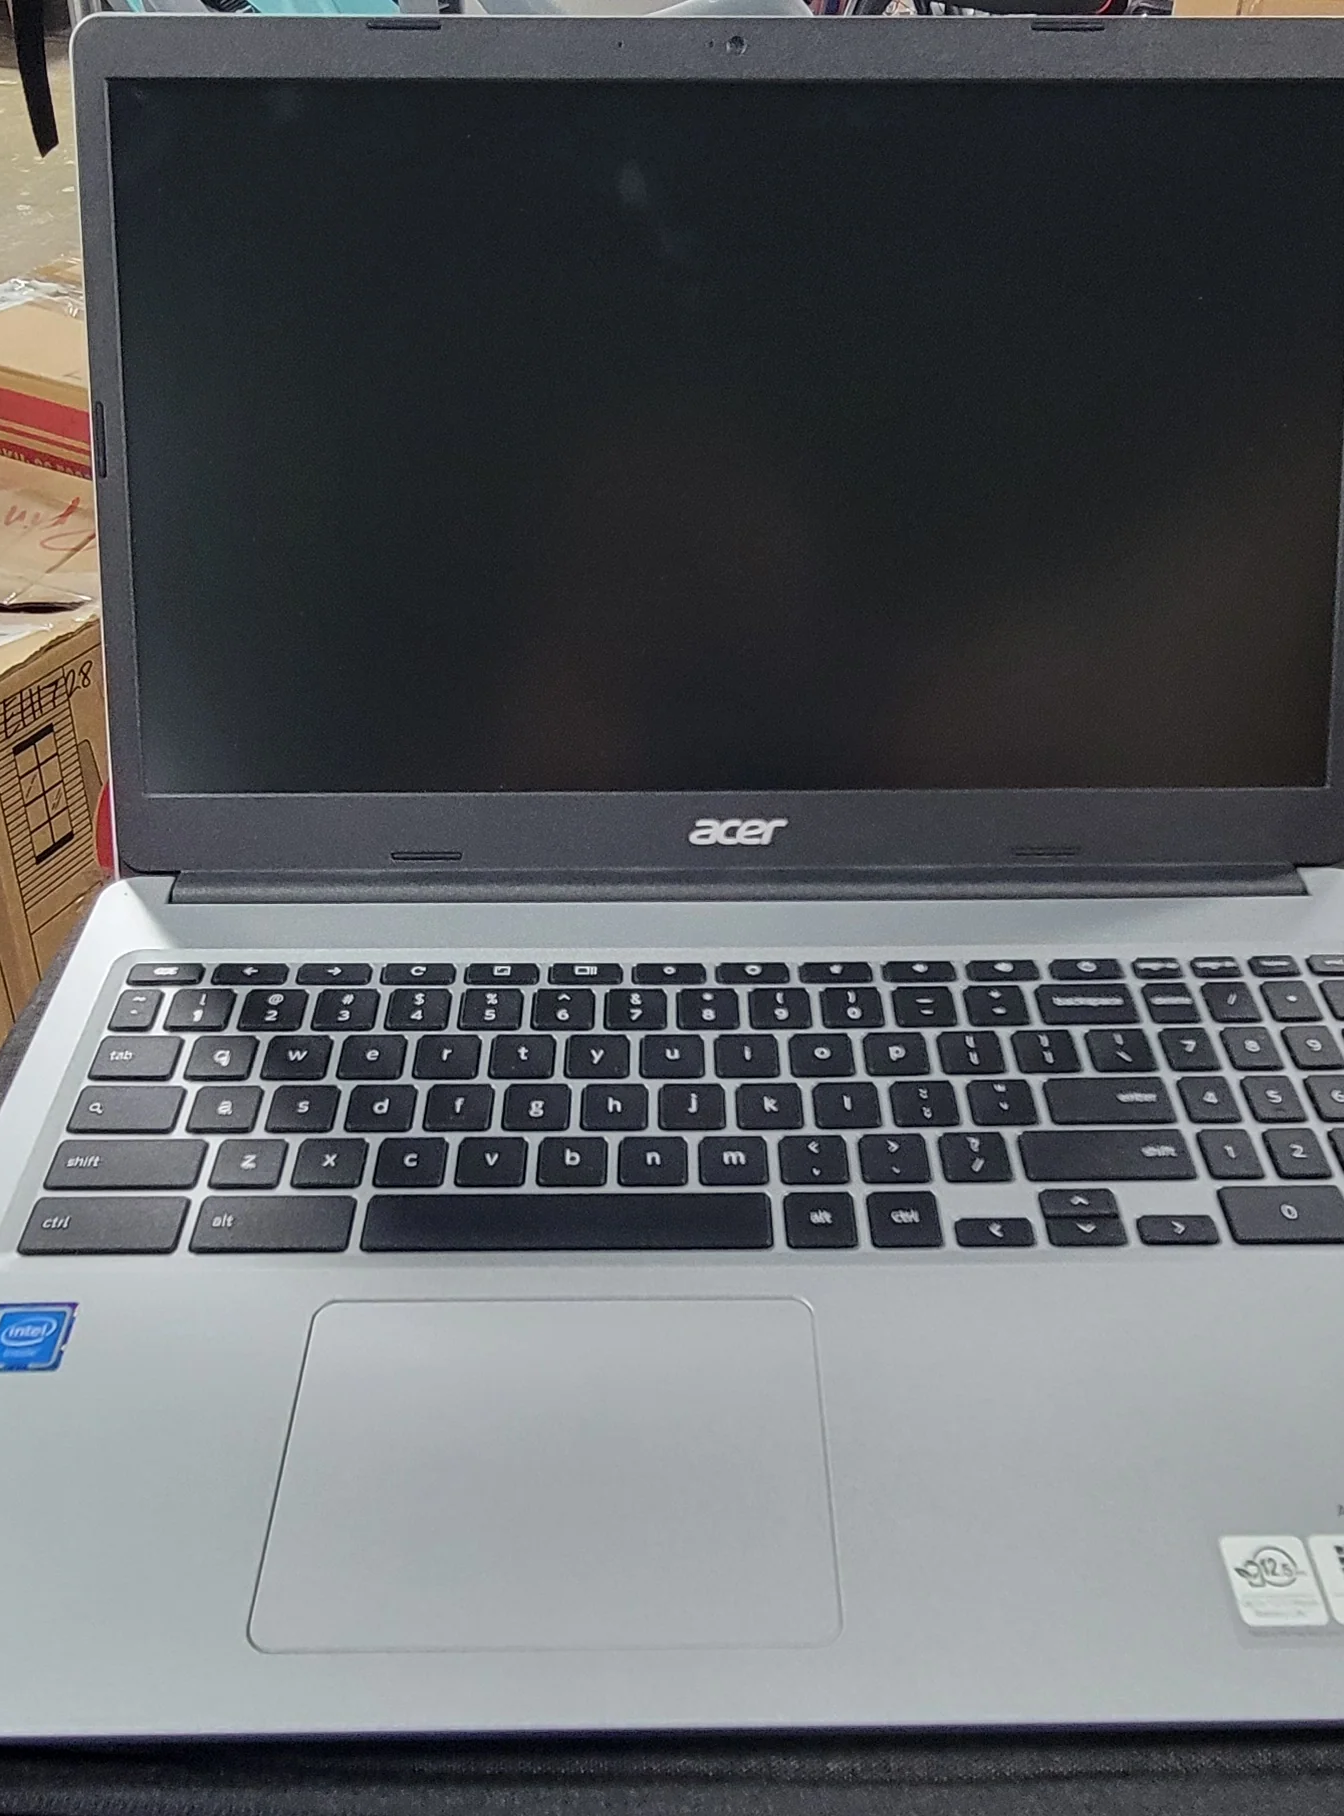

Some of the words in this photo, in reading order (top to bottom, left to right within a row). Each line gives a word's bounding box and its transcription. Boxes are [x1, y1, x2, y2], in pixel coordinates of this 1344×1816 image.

[688, 818, 789, 845] acer
[264, 1010, 278, 1021] 2
[338, 1010, 350, 1020] 3
[410, 1010, 422, 1020] 4
[484, 1010, 496, 1020] 5
[556, 1010, 569, 1020] 6
[630, 1009, 642, 1020] 7
[702, 1010, 716, 1020] 8
[774, 1008, 788, 1020] 9
[847, 1007, 862, 1018] 0
[1180, 1040, 1196, 1052] 7
[1244, 1040, 1260, 1052] 8
[1306, 1040, 1322, 1051] 9
[110, 1050, 132, 1060] tab
[214, 1050, 230, 1066] q
[288, 1050, 308, 1060] w
[366, 1050, 379, 1060] e
[442, 1049, 452, 1060] r
[518, 1047, 528, 1060] t
[591, 1050, 604, 1064] y
[666, 1048, 679, 1059] u
[744, 1046, 751, 1060] i
[814, 1048, 830, 1058] o
[889, 1046, 905, 1060] p
[1203, 1092, 1218, 1104] 4
[1266, 1090, 1282, 1102] 5
[218, 1100, 232, 1114] a
[298, 1100, 309, 1112] s
[373, 1099, 389, 1114] d
[455, 1098, 464, 1113] f
[528, 1100, 544, 1117] g
[608, 1097, 622, 1112] h
[688, 1094, 698, 1112] j
[764, 1096, 778, 1112] k
[1224, 1146, 1236, 1158] 1
[1290, 1144, 1307, 1158] 2
[66, 1156, 100, 1166] shift
[322, 1154, 336, 1166] x
[404, 1154, 418, 1166] c
[486, 1153, 498, 1165] v
[565, 1149, 580, 1166] b
[646, 1152, 660, 1165] n
[723, 1151, 746, 1164] m
[1280, 1204, 1298, 1219] 0
[42, 1216, 70, 1228] ctrl
[212, 1214, 233, 1226] alt
[8, 1322, 49, 1338] intel
